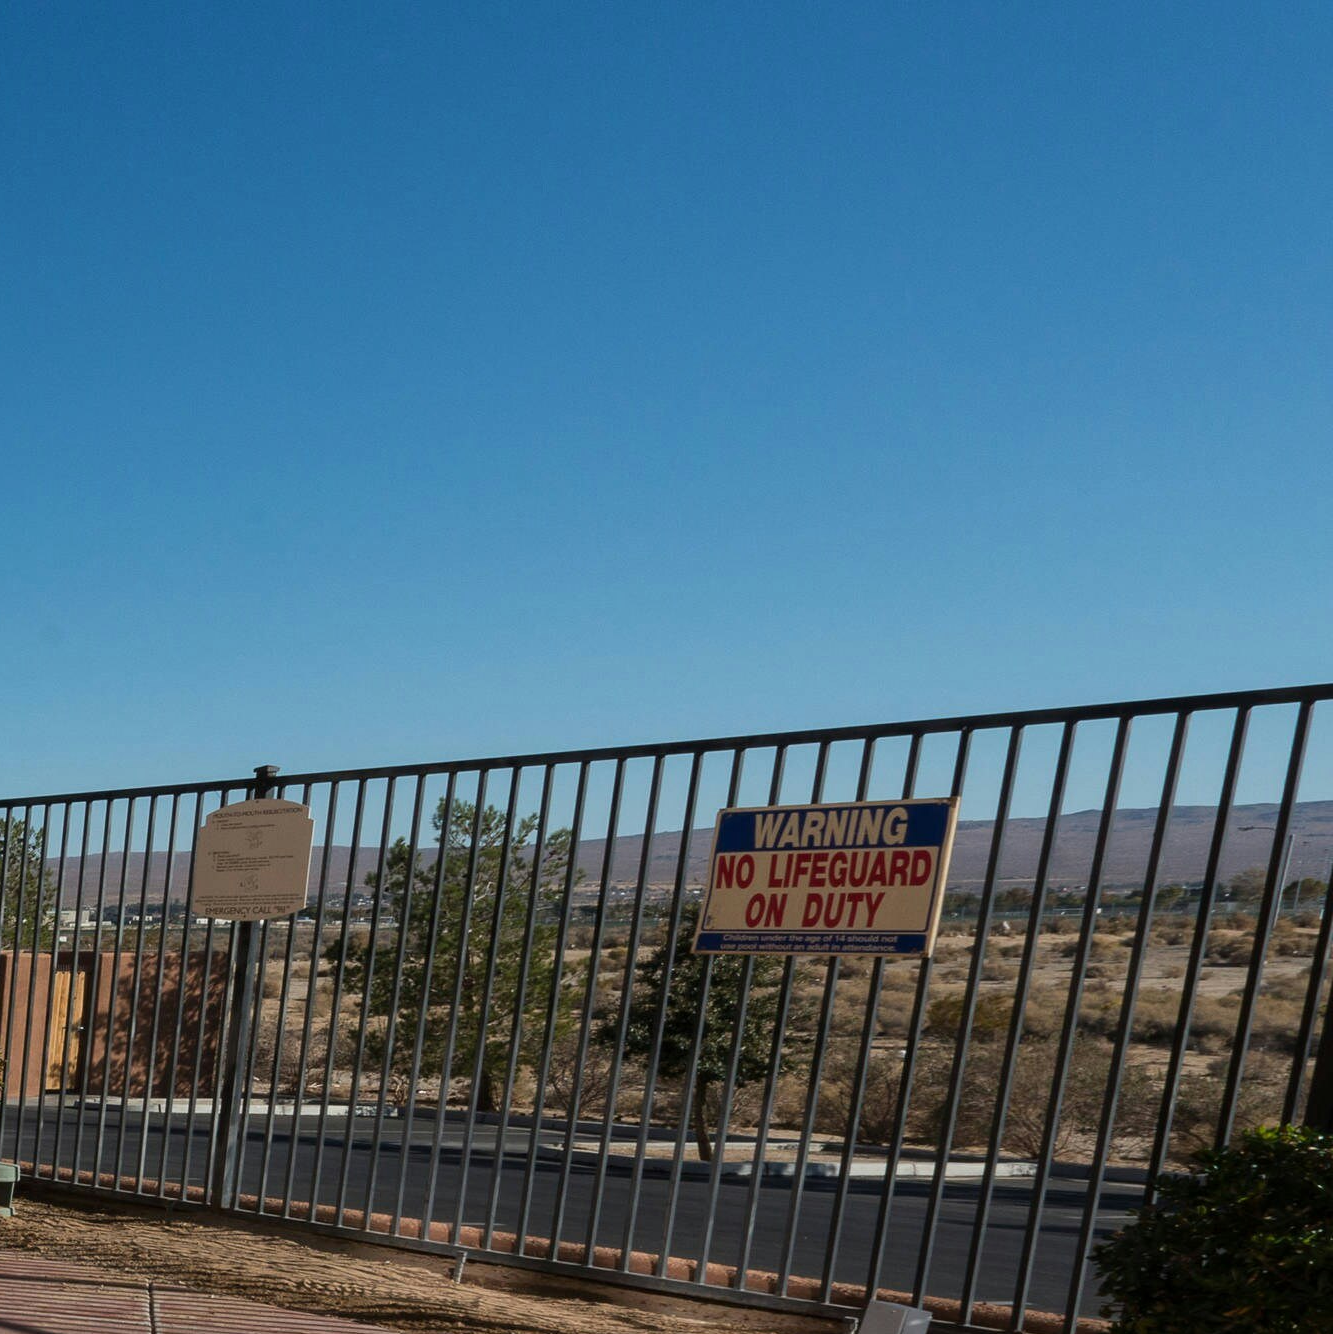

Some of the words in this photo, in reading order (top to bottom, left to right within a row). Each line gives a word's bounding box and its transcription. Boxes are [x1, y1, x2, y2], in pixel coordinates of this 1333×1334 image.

[754, 807, 909, 849] WARNING
[716, 854, 755, 889] NO
[768, 850, 932, 888] LIFEGUARD
[205, 906, 251, 915] EMERGENCY
[252, 906, 271, 914] CALL
[745, 893, 787, 928] ON
[802, 892, 885, 928] DUTY
[723, 934, 759, 942] Children
[761, 934, 787, 942] under
[789, 934, 803, 942] the
[823, 934, 832, 942] of
[847, 935, 879, 943] should
[882, 935, 898, 943] not
